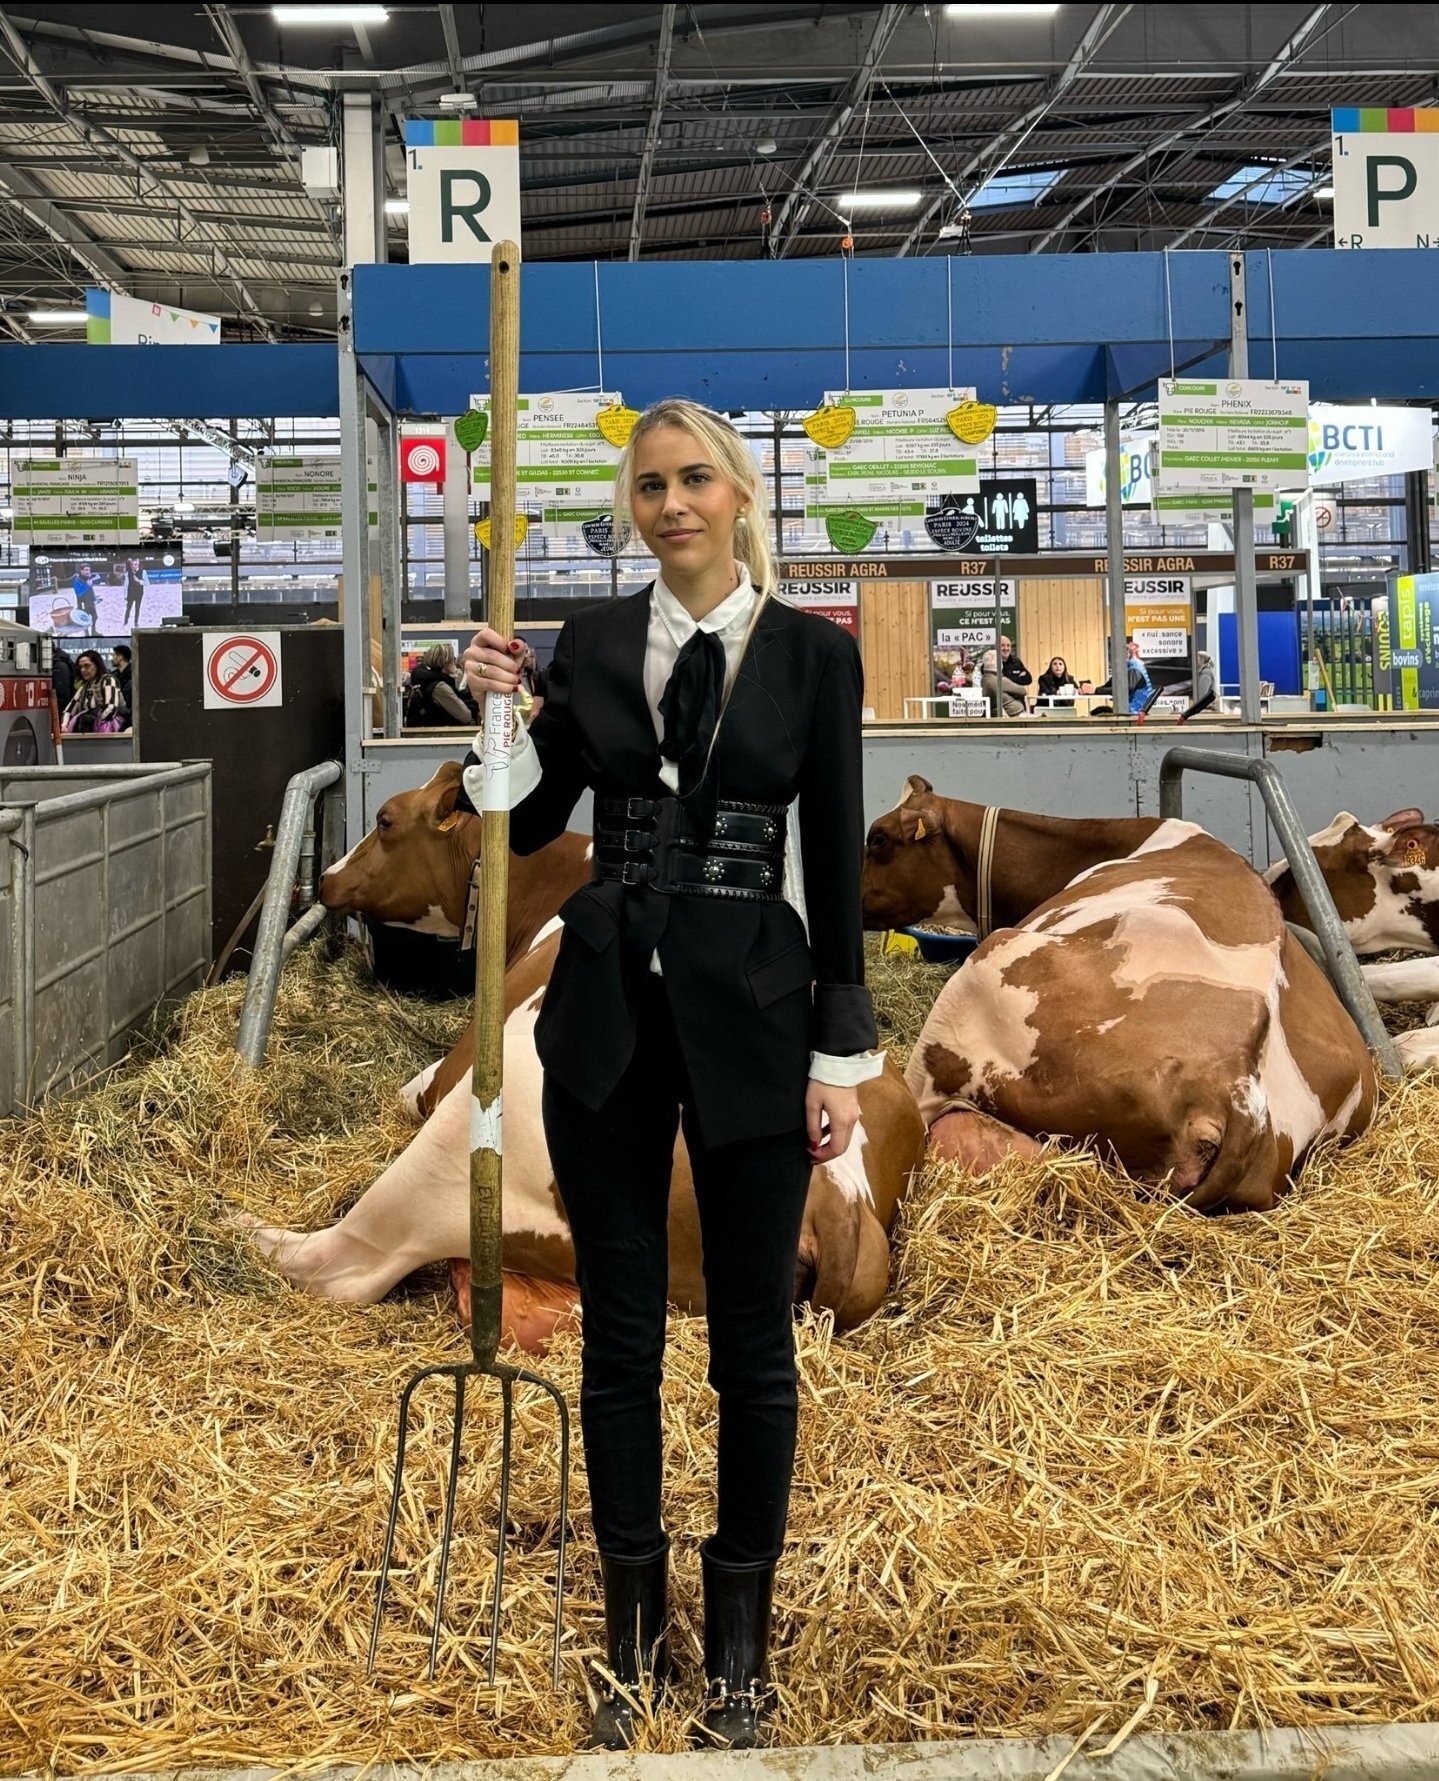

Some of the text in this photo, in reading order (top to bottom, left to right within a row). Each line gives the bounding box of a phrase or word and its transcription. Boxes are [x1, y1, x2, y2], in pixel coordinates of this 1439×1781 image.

[1334, 136, 1348, 156] 1.
[408, 149, 422, 170] 1.
[1366, 156, 1418, 227] P
[440, 170, 492, 242] R
[1351, 234, 1363, 248] R
[1417, 234, 1429, 248] N
[1322, 424, 1382, 451] BCTI
[975, 534, 1013, 543] toilettes
[980, 543, 1008, 551] toilets
[961, 562, 986, 574] R37
[1095, 557, 1194, 572] RESSIR AGRA
[1269, 556, 1295, 569] R37
[789, 563, 887, 577] REUSSIR AGRA
[1401, 589, 1414, 640] tapis
[942, 633, 950, 642] la
[962, 632, 983, 641] PAC
[1393, 652, 1419, 666] bovins
[490, 692, 502, 734] France
[1406, 854, 1425, 865] 9346
